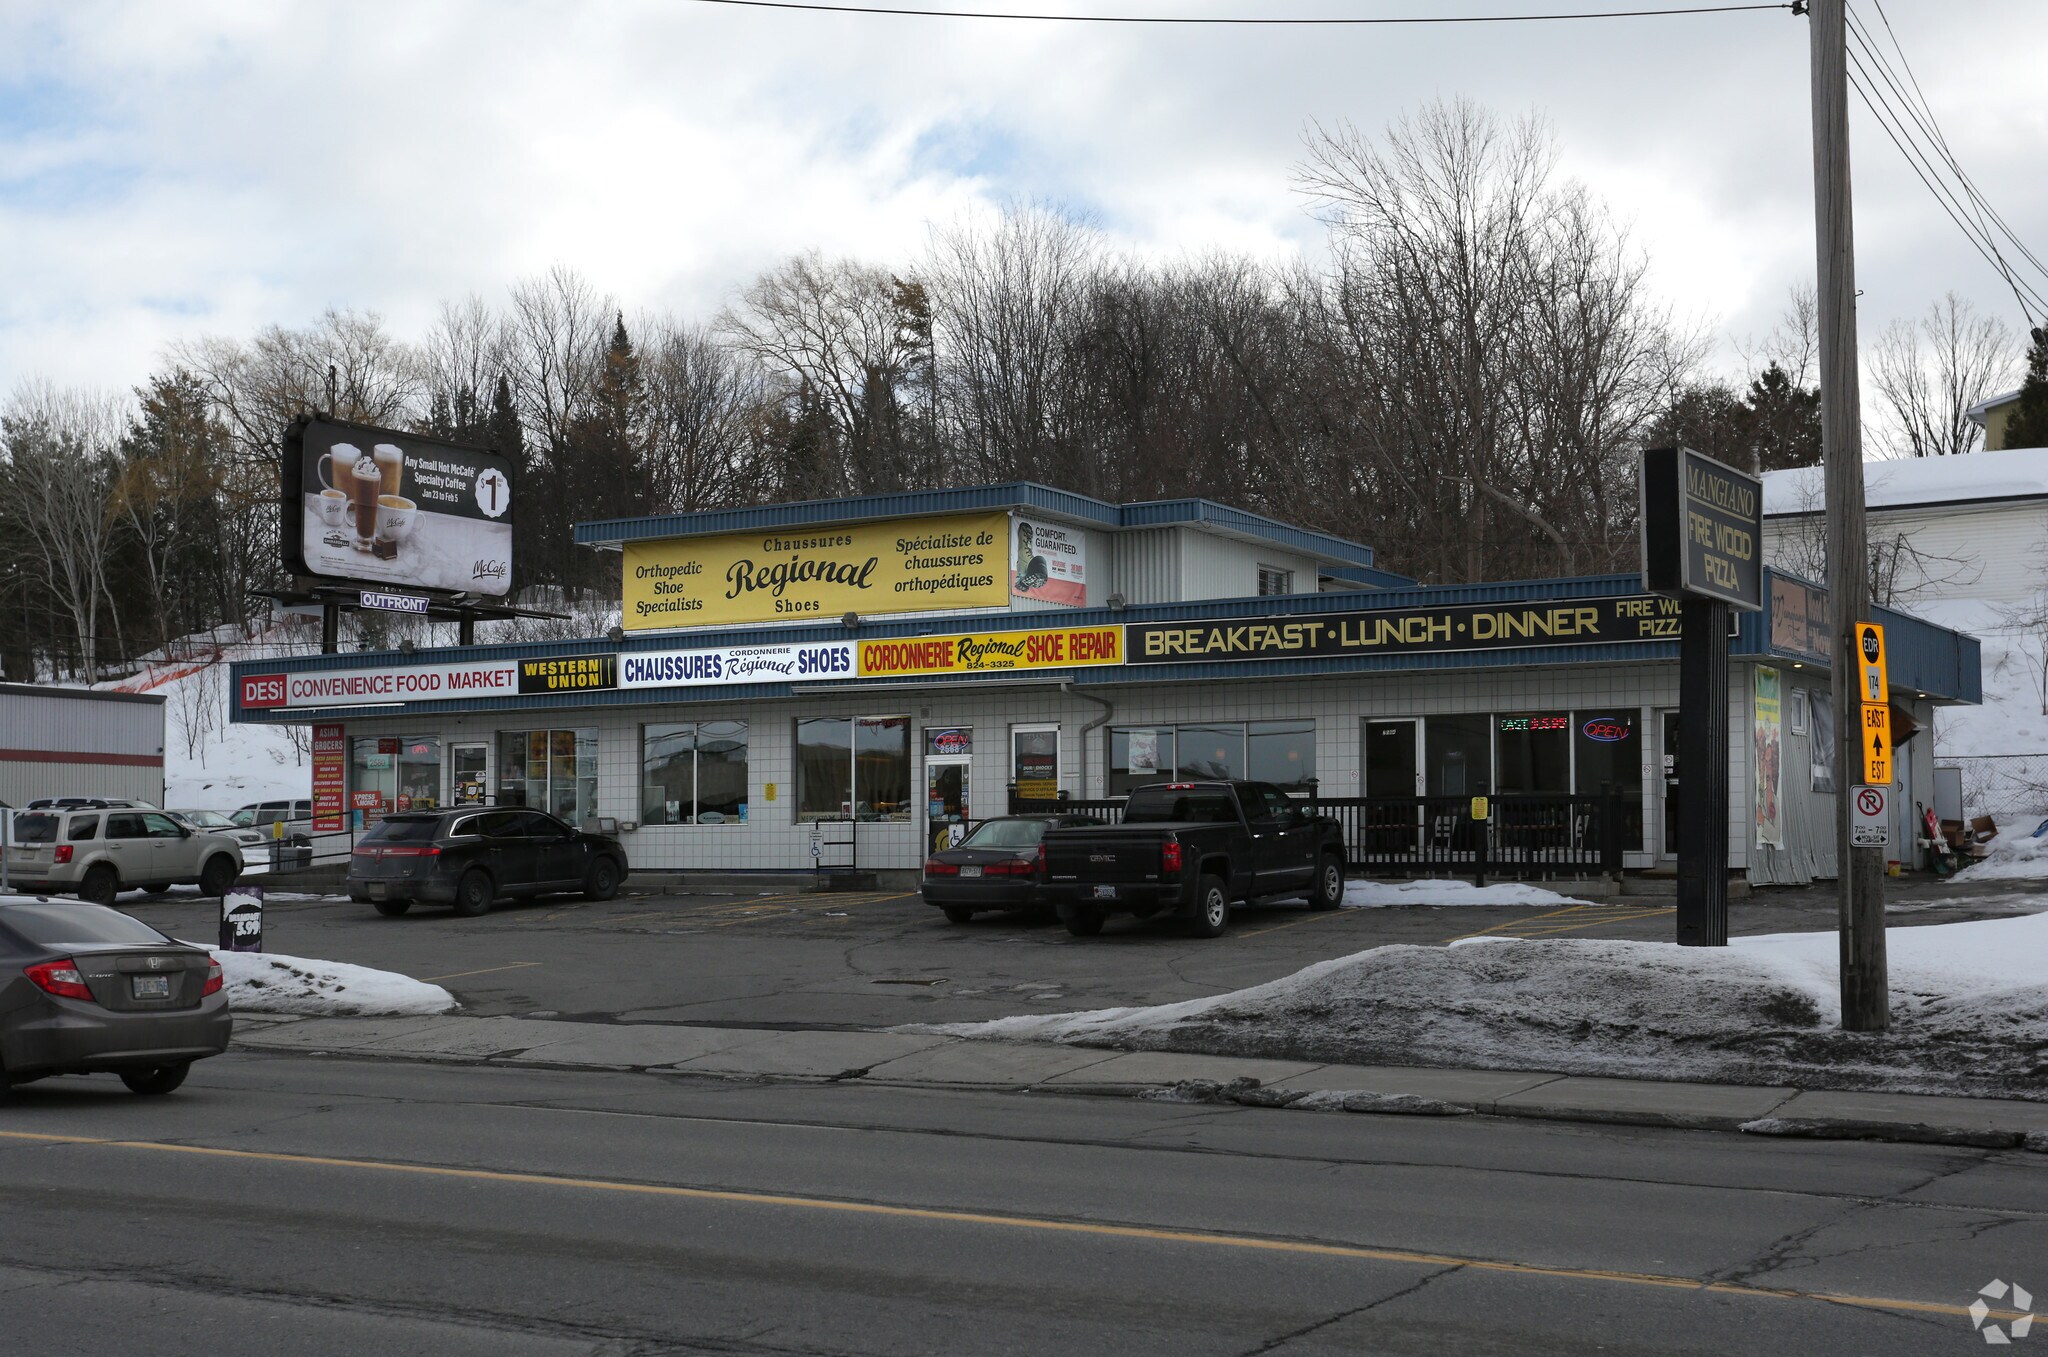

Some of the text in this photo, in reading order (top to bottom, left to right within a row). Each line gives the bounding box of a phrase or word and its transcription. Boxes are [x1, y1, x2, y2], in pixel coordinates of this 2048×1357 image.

[405, 456, 418, 470] Any
[419, 458, 437, 471] Small
[438, 462, 450, 473] Hot
[414, 472, 466, 490] Specialty Coffee
[422, 489, 432, 498] Jan
[432, 490, 438, 498] 23
[440, 492, 445, 500] to
[446, 492, 454, 502] Feb
[1688, 465, 1754, 516] MANGIANO
[763, 535, 852, 552] Chaussures
[896, 531, 993, 553] Spécialiste de
[1689, 510, 1752, 560] FIRE WOOD
[1035, 538, 1078, 555] GUARANTEED.
[472, 560, 506, 579] McCafé
[904, 553, 983, 570] chaussures
[635, 562, 702, 580] Orthopedic
[725, 555, 879, 600] Regional
[1704, 553, 1740, 592] PIZZA
[653, 581, 683, 595] Shoe
[894, 572, 994, 595] orthopédiques
[363, 594, 425, 612] OUTFRONT
[636, 599, 703, 616] Specialists
[775, 600, 820, 613] Shoes
[1616, 600, 1654, 618] FIRE
[1145, 607, 1600, 656] BREAKFAST LUNCH DINNER
[1639, 619, 1682, 636] PIZZ
[729, 648, 791, 657] CORDONNERIE
[1026, 631, 1115, 663] SHOE REPAIR
[1864, 638, 1878, 652] EDR
[864, 637, 1026, 672] CORDONNERIE Regional
[524, 658, 599, 677] WESTERN
[625, 647, 850, 682] CHAUSSURES Régional SHOES
[966, 660, 1014, 670] 824-3325
[292, 673, 392, 698] CONVENIENCE
[397, 673, 440, 692] FOOD
[449, 669, 515, 690] MARKET
[548, 673, 599, 689] UNION
[1869, 676, 1878, 690] 174
[1866, 709, 1885, 728] EAST
[320, 728, 339, 737] ASIAN
[1585, 723, 1628, 738] OPEN
[315, 740, 343, 750] GROCERS
[936, 735, 968, 746] OPEN
[1872, 761, 1885, 779] EST
